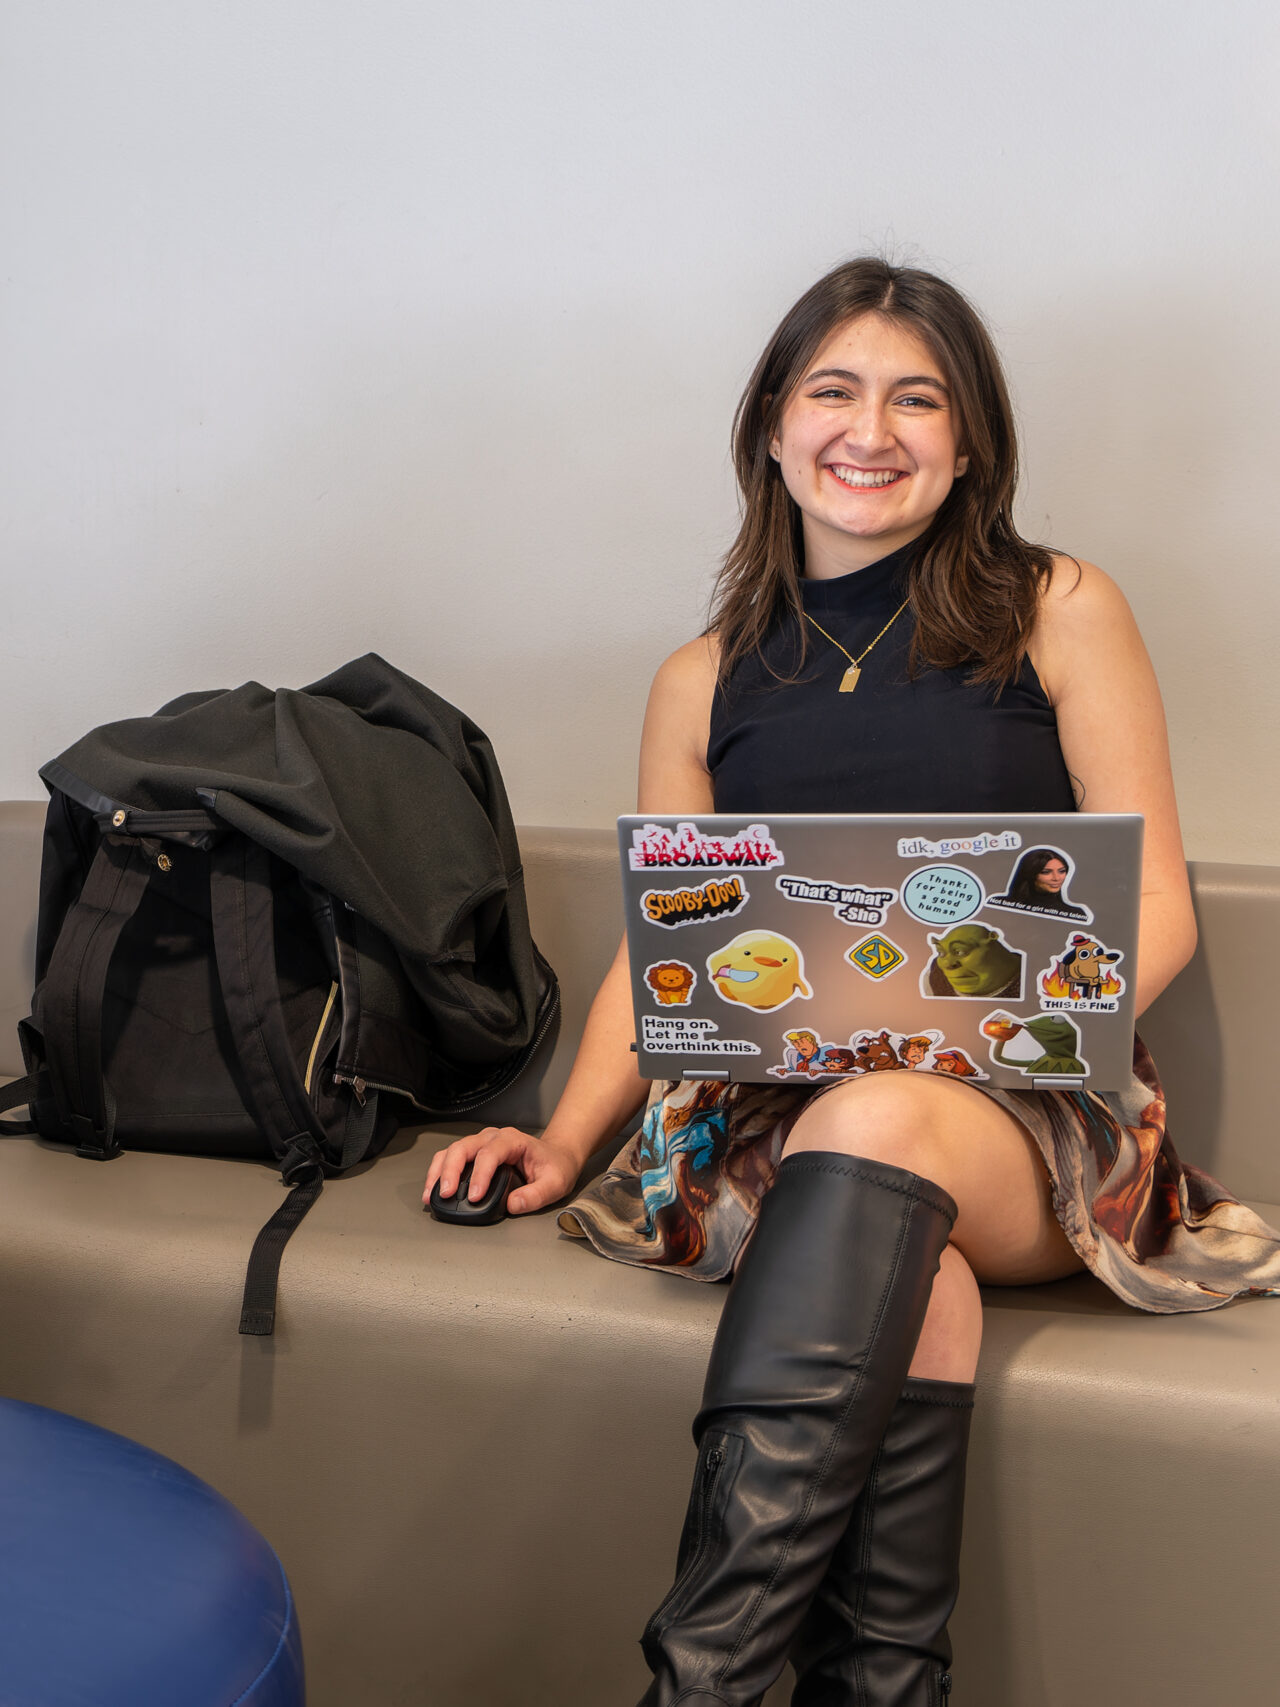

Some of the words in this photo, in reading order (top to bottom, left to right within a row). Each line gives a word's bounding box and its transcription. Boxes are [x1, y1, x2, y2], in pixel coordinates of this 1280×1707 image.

[901, 841, 935, 855] idk,
[939, 835, 1000, 855] google
[1004, 833, 1017, 848] it
[928, 874, 969, 890] Thanks
[915, 882, 936, 892] for
[940, 887, 974, 902] being
[932, 896, 961, 908] good
[918, 902, 957, 917] human
[1044, 907, 1059, 915] with
[861, 942, 896, 969] SD
[1044, 1001, 1072, 1009] THIS
[1089, 1002, 1116, 1011] FINE
[644, 1018, 685, 1031] Hang
[689, 1020, 714, 1030] on.
[645, 1029, 671, 1040] Let
[675, 1031, 699, 1040] me
[646, 1041, 720, 1051] overthink
[723, 1043, 757, 1053] this.
